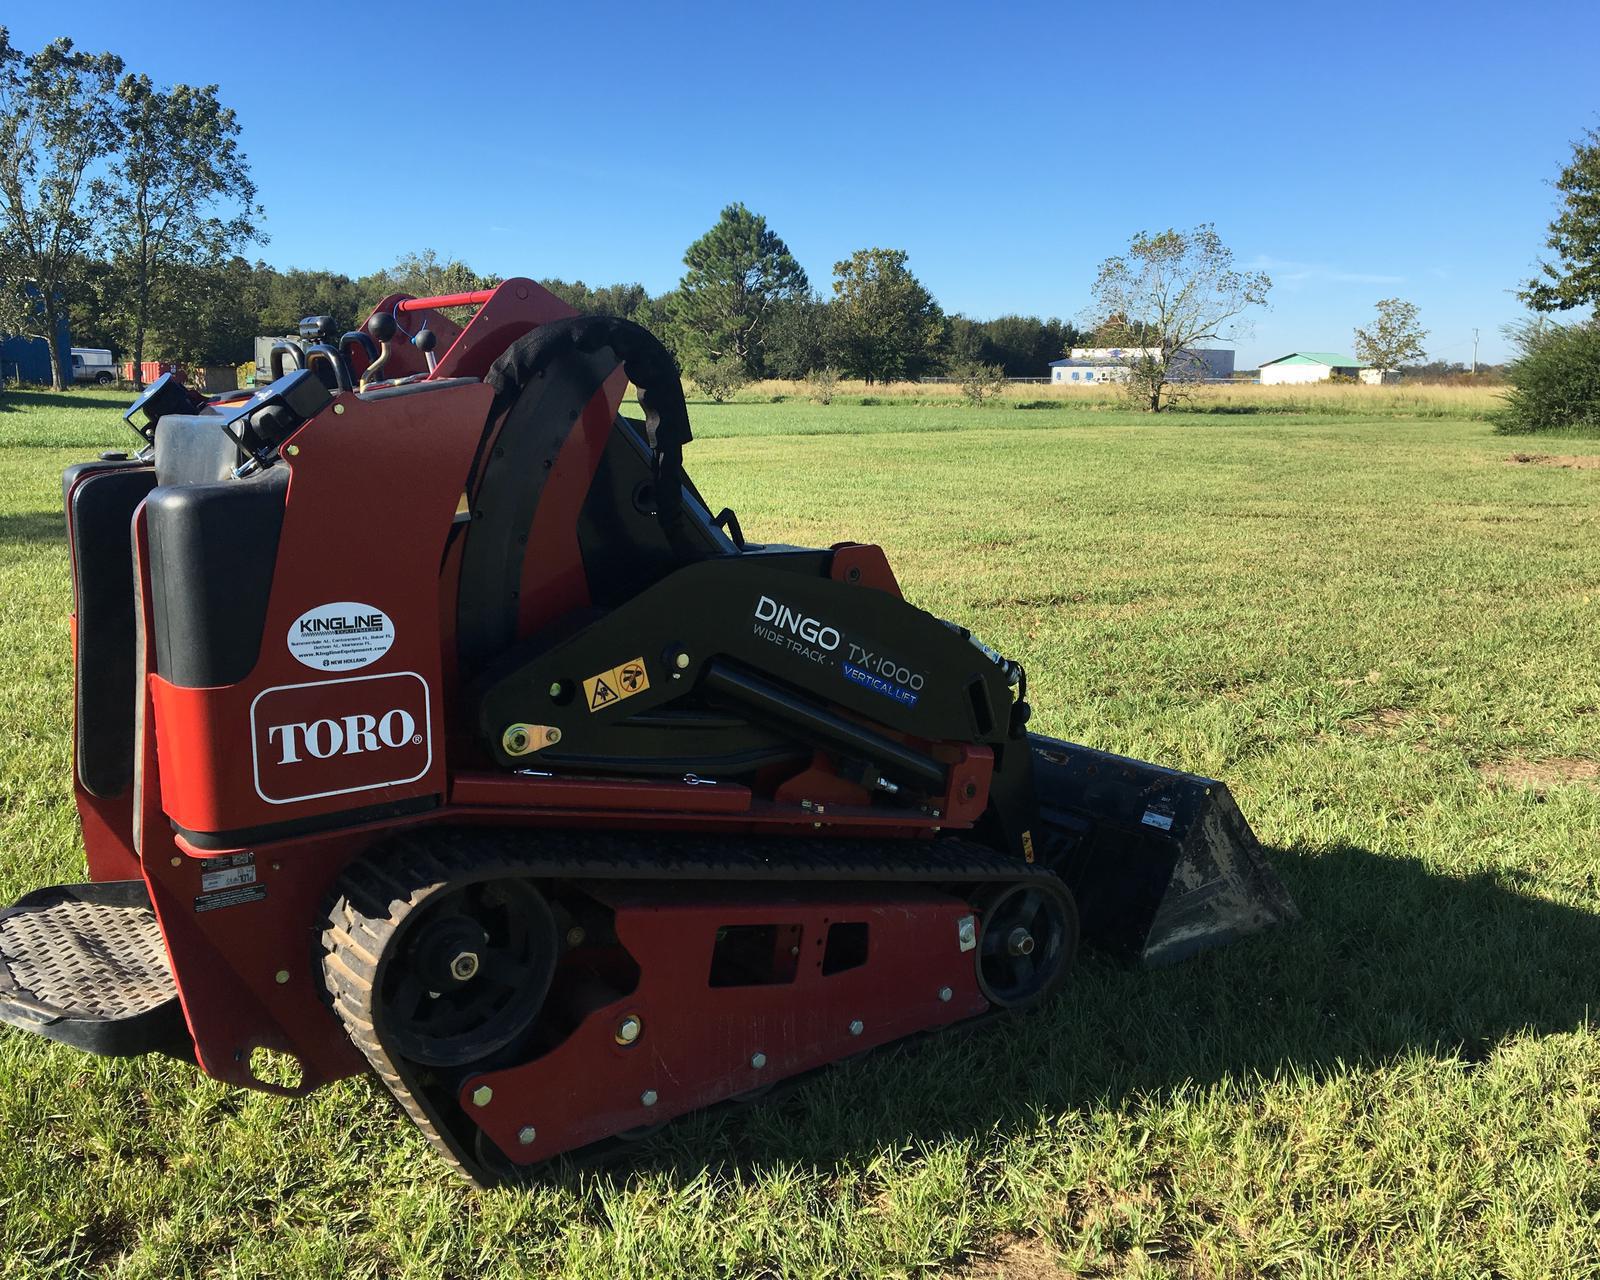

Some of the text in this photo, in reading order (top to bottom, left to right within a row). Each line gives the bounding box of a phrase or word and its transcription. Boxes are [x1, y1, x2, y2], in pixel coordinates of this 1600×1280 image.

[300, 614, 383, 632] KINGLINE
[755, 595, 840, 651] DINGO
[298, 646, 387, 658] www.KinglineEquipment.com
[753, 624, 827, 665] WIDE TRACK
[343, 657, 367, 665] HOLLAND
[844, 665, 917, 704] VERTICAL LIFT
